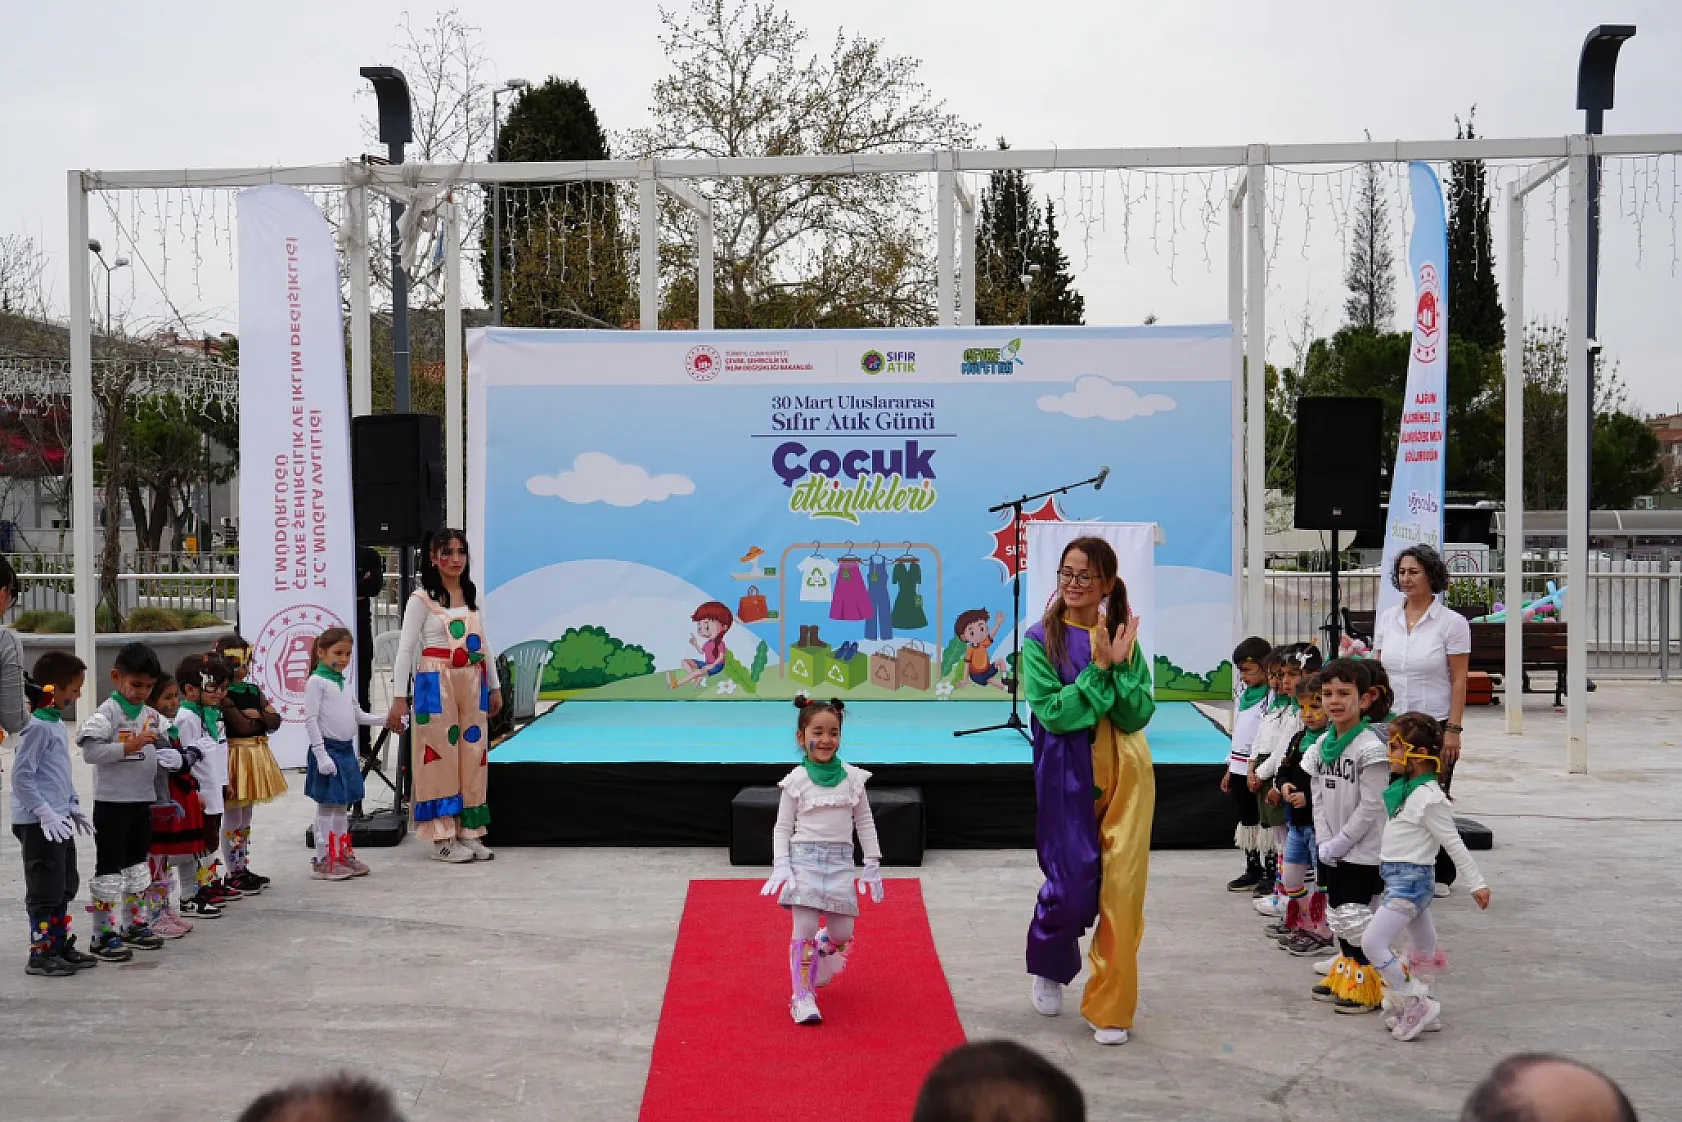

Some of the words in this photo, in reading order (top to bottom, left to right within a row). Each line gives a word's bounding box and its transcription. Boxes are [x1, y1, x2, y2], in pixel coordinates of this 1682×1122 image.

[886, 351, 916, 362] SIFIR
[887, 362, 916, 373] ATIK
[771, 395, 791, 410] 30
[794, 395, 833, 410] Mart
[838, 395, 935, 410] Uluslararası
[771, 412, 820, 431] Sıfır
[825, 412, 871, 431] Atık
[875, 412, 936, 431] Günü
[772, 439, 937, 487] Çocuk
[790, 473, 937, 524] etkinlikleri
